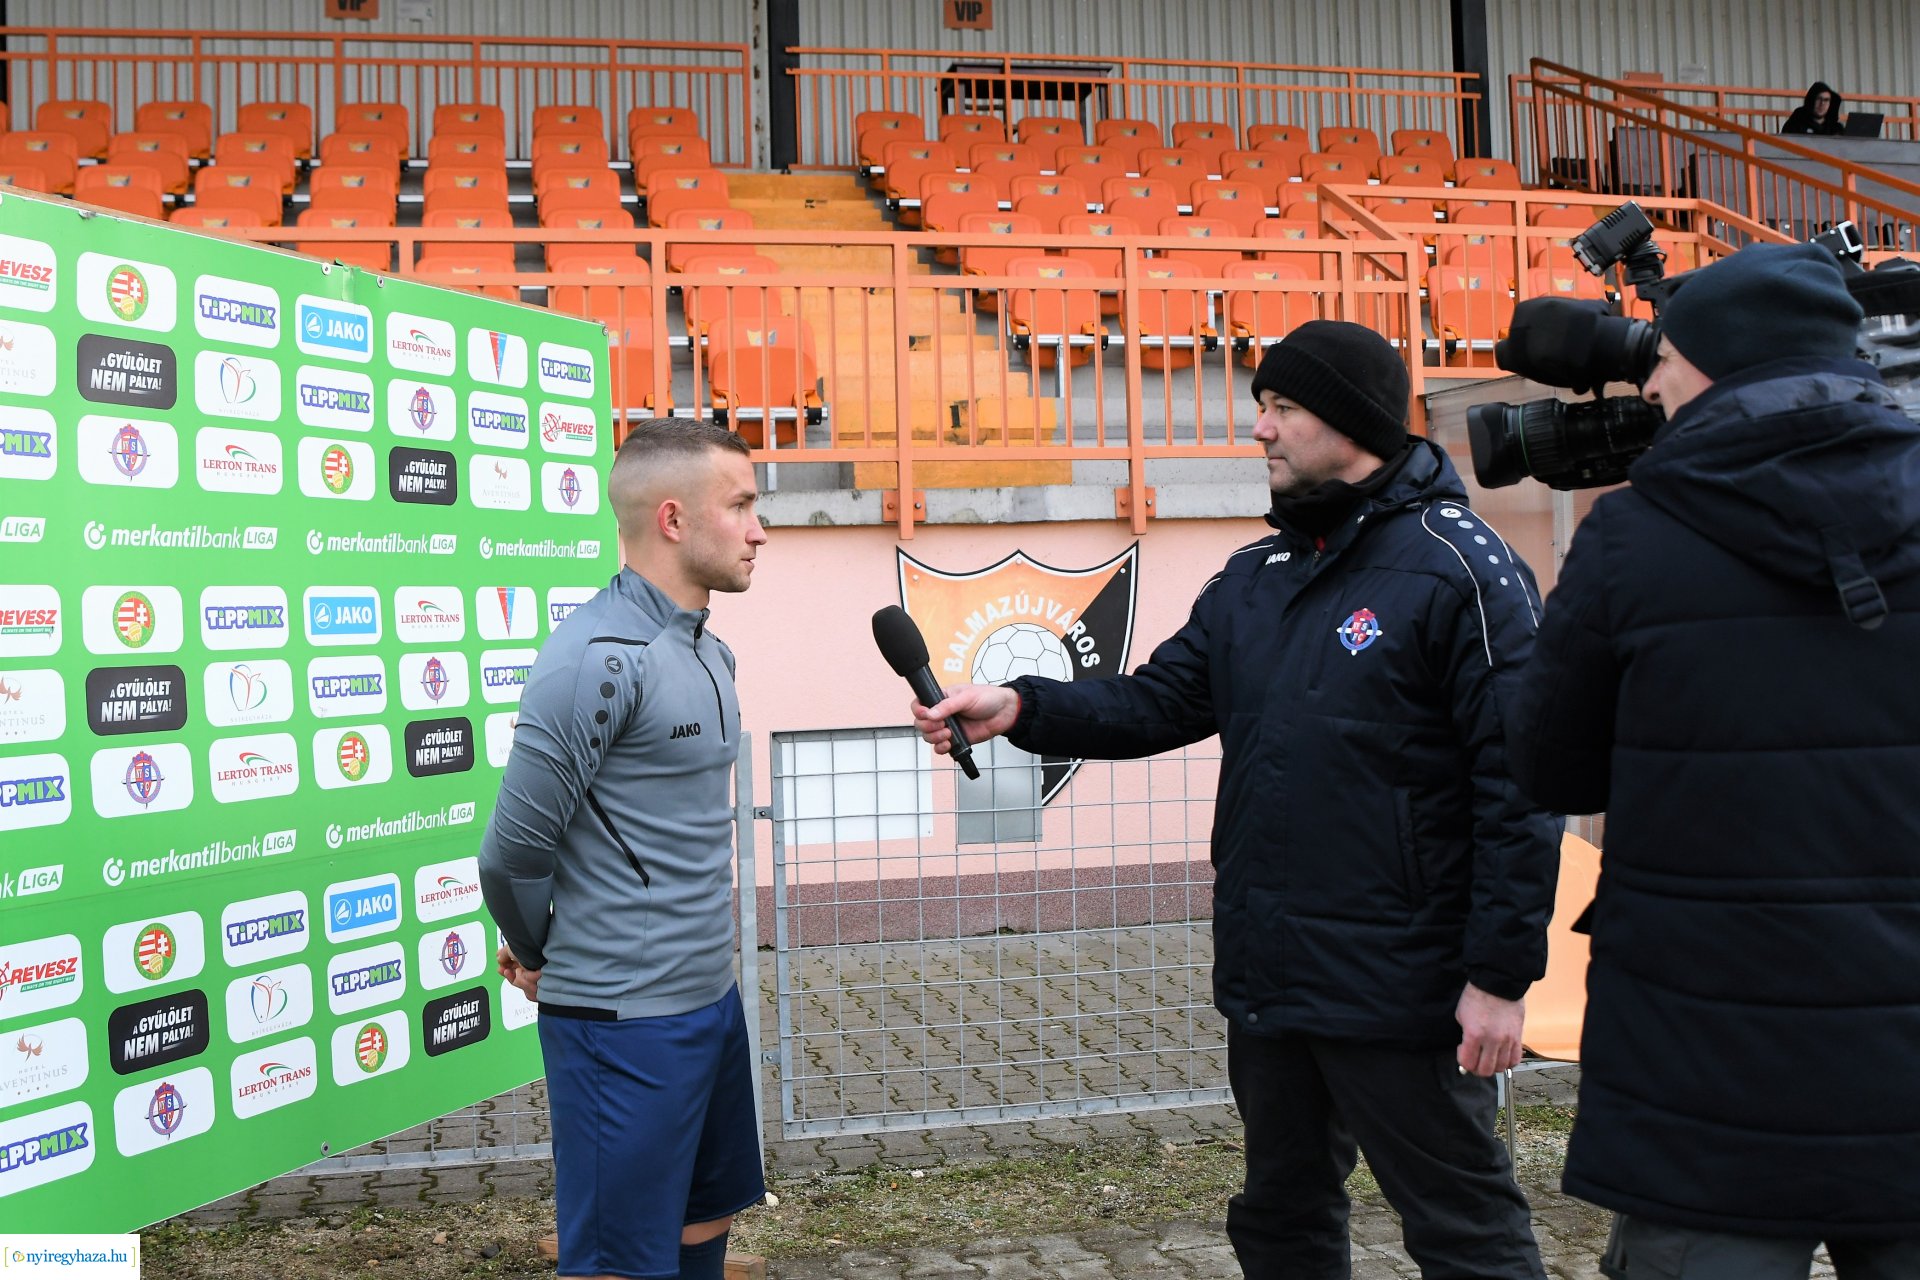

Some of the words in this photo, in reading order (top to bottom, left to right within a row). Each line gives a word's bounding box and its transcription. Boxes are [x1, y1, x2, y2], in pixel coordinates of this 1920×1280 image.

[954, 0, 983, 22] VIP
[326, 322, 364, 342] JAKO
[392, 339, 425, 354] LERTON
[426, 345, 451, 358] TRANS
[101, 357, 107, 366] A
[107, 351, 162, 375] GYŰLÖLET
[91, 369, 126, 392] NEM
[129, 372, 162, 391] PÁLYA!
[561, 421, 594, 436] REVESZ
[203, 458, 244, 473] LERTON
[245, 461, 277, 475] TRANS
[404, 465, 409, 473] A
[409, 459, 447, 476] GYŰLÖLET
[398, 475, 423, 493] NEM
[424, 477, 447, 490] PÁLYA!
[5, 522, 41, 538] LIGA
[111, 524, 241, 549] merkantilbank
[247, 530, 275, 545] LIGA
[327, 532, 428, 554] merkantilbank
[432, 536, 455, 551] LIGA
[495, 538, 576, 558] merkantilbank
[579, 542, 599, 556] LIGA
[1265, 551, 1291, 566] JAKO
[335, 605, 372, 625] JAKO
[401, 613, 433, 624] LERTON
[433, 613, 460, 623] TRANS
[943, 590, 1101, 674] BALMAZÚJVÁROS
[484, 665, 533, 687] TiPPMI
[110, 689, 116, 698] A
[116, 678, 171, 697] GYŰLÖLET
[100, 701, 137, 723] NEM
[139, 697, 172, 714] PÁLYA!
[421, 738, 425, 746] A
[425, 728, 463, 746] GYŰLÖLET
[669, 722, 701, 740] JAKO
[416, 746, 440, 767] NEM
[441, 743, 464, 758] PÁLYA!
[218, 767, 258, 781] LERTON
[258, 764, 293, 777] TRANS
[0, 775, 65, 807] PMIX
[347, 807, 447, 842] merkantilbank
[451, 805, 473, 821] LIGA
[130, 836, 261, 879] merkantilbank
[265, 835, 294, 851] LIGA
[22, 872, 59, 890] LIGA
[421, 890, 452, 904] LERTON
[453, 883, 479, 897] TRANS
[354, 893, 393, 918] JAKO
[10, 956, 78, 985] REVESZ
[132, 1025, 138, 1035] A
[139, 1005, 194, 1032] GYŰLÖLET
[438, 1016, 443, 1024] A
[443, 999, 480, 1022] GYŰLÖLET
[433, 1022, 457, 1046] NEM
[458, 1015, 481, 1032] PÁLYA!
[124, 1036, 159, 1061] NEM
[162, 1024, 194, 1045] PÁLYA!
[238, 1076, 278, 1098] LERTON
[278, 1066, 311, 1085] TRANS
